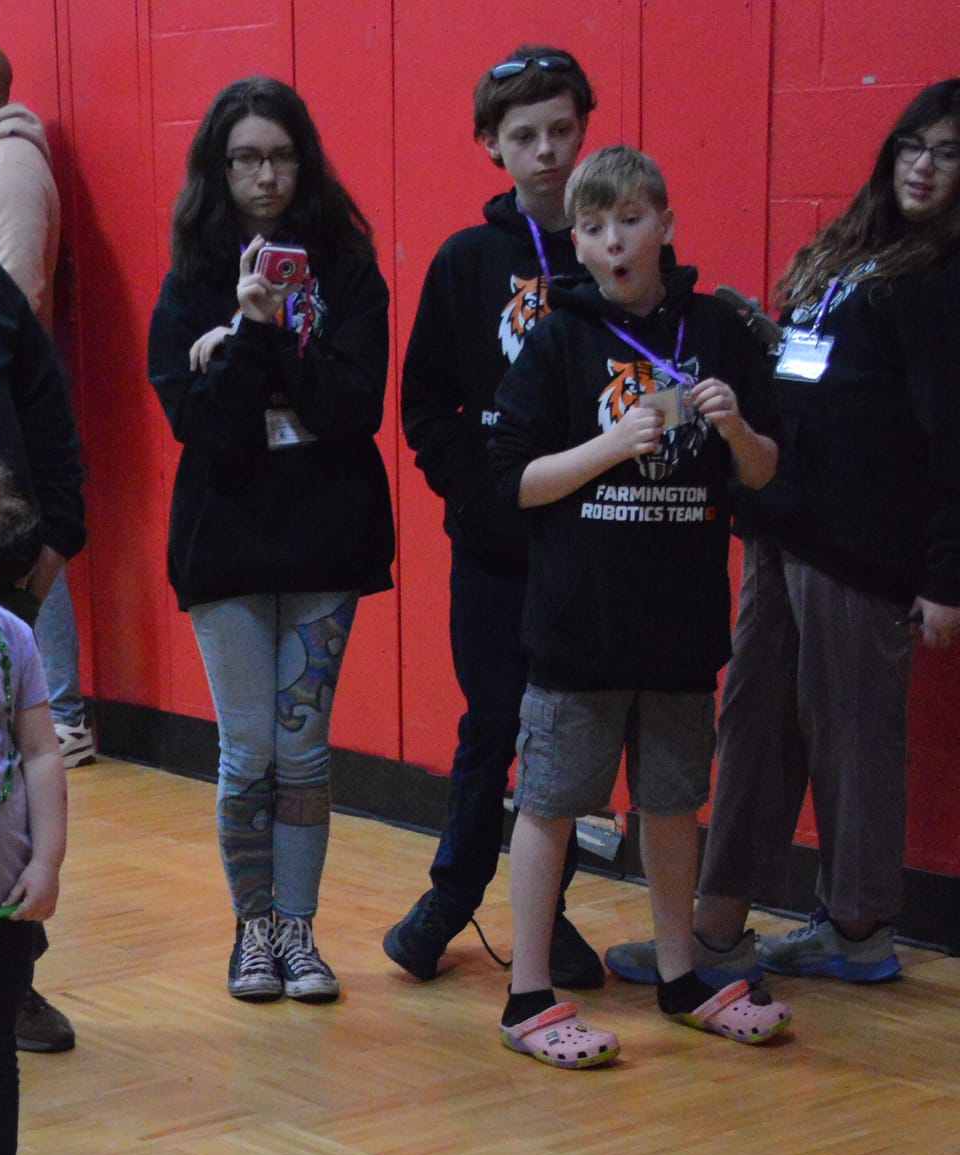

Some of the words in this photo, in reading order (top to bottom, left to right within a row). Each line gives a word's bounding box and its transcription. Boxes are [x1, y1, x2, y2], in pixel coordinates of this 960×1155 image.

[596, 484, 707, 502] FARMINGTON
[580, 502, 664, 522] ROBOTICS
[666, 506, 704, 522] TEAM
